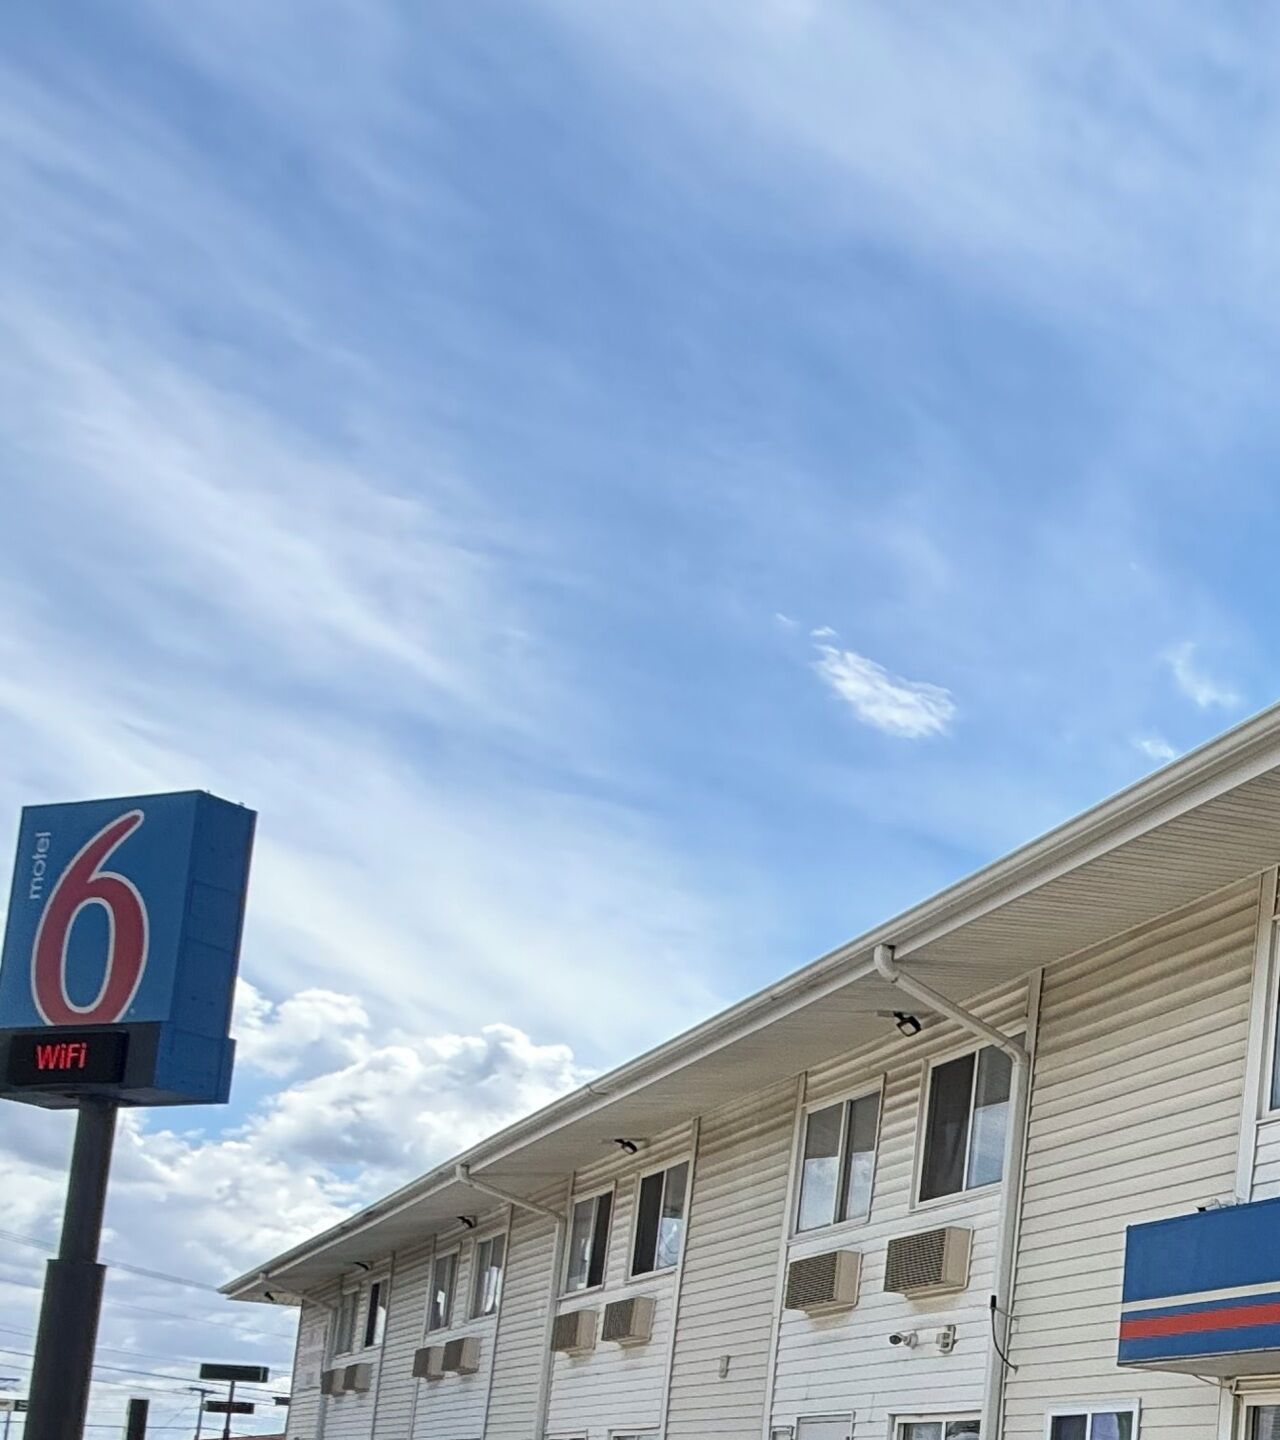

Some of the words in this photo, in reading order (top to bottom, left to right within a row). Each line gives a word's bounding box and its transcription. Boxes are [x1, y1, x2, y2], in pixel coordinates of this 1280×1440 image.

[29, 831, 52, 899] motel
[31, 809, 149, 1027] 6
[36, 1043, 87, 1069] WiFi
